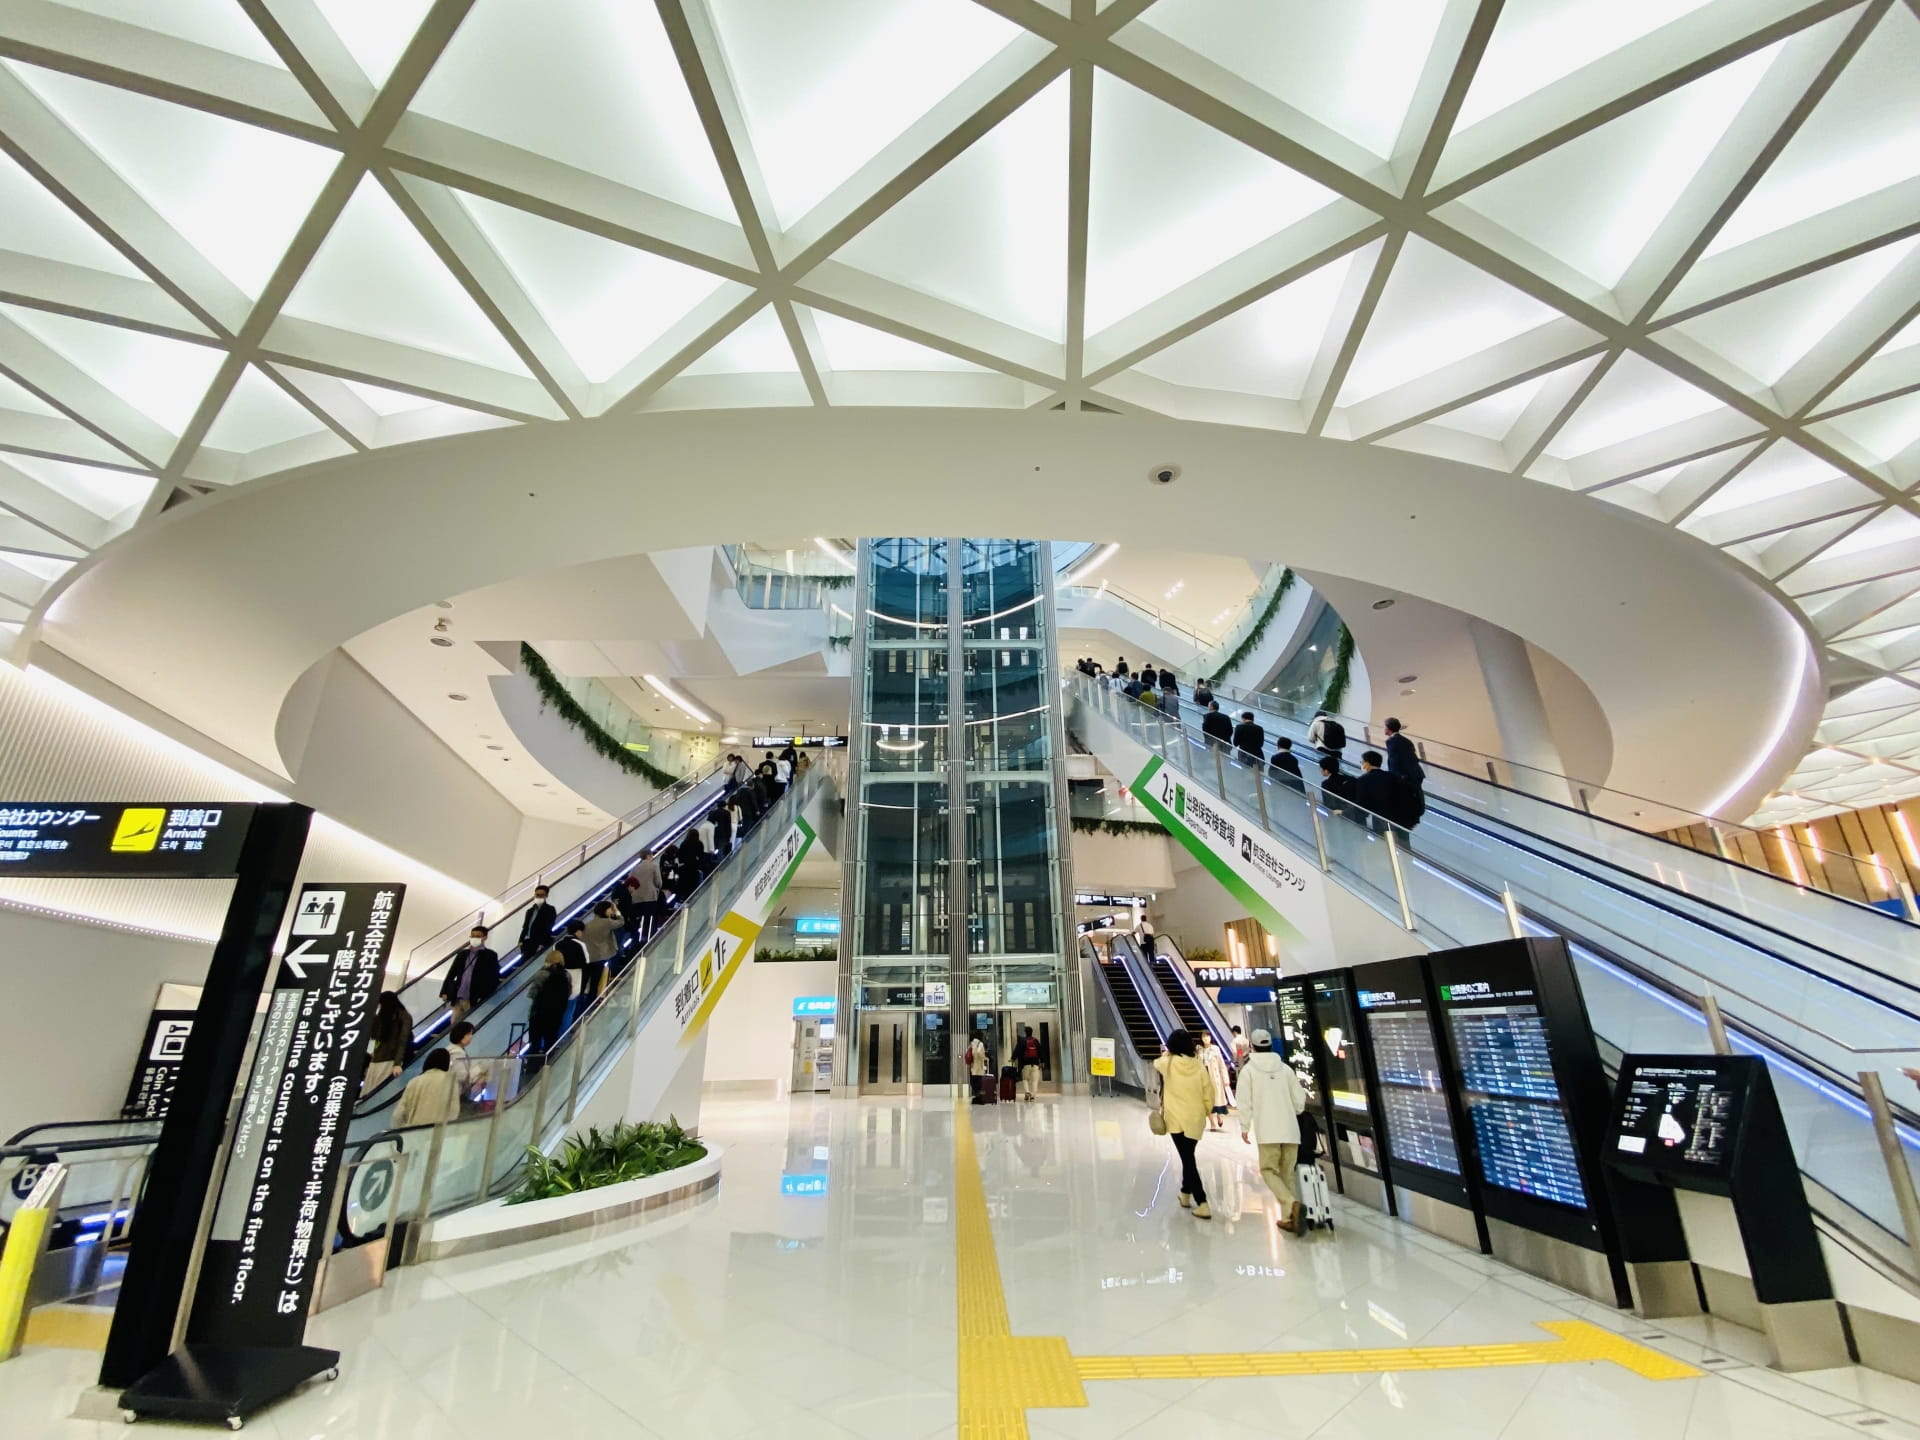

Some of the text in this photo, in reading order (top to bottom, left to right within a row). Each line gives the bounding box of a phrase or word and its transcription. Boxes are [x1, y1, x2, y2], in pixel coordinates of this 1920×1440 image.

[1162, 772, 1174, 809] 2F
[0, 808, 101, 826] 会社カウンター
[168, 809, 223, 826] 到着口
[0, 828, 39, 838] ounters
[163, 828, 207, 838] Arrivals
[714, 936, 727, 971] 1F
[674, 969, 699, 1019] 到着口
[153, 1067, 168, 1090] Coin
[231, 988, 321, 1304] The airline counter is on the first floor.
